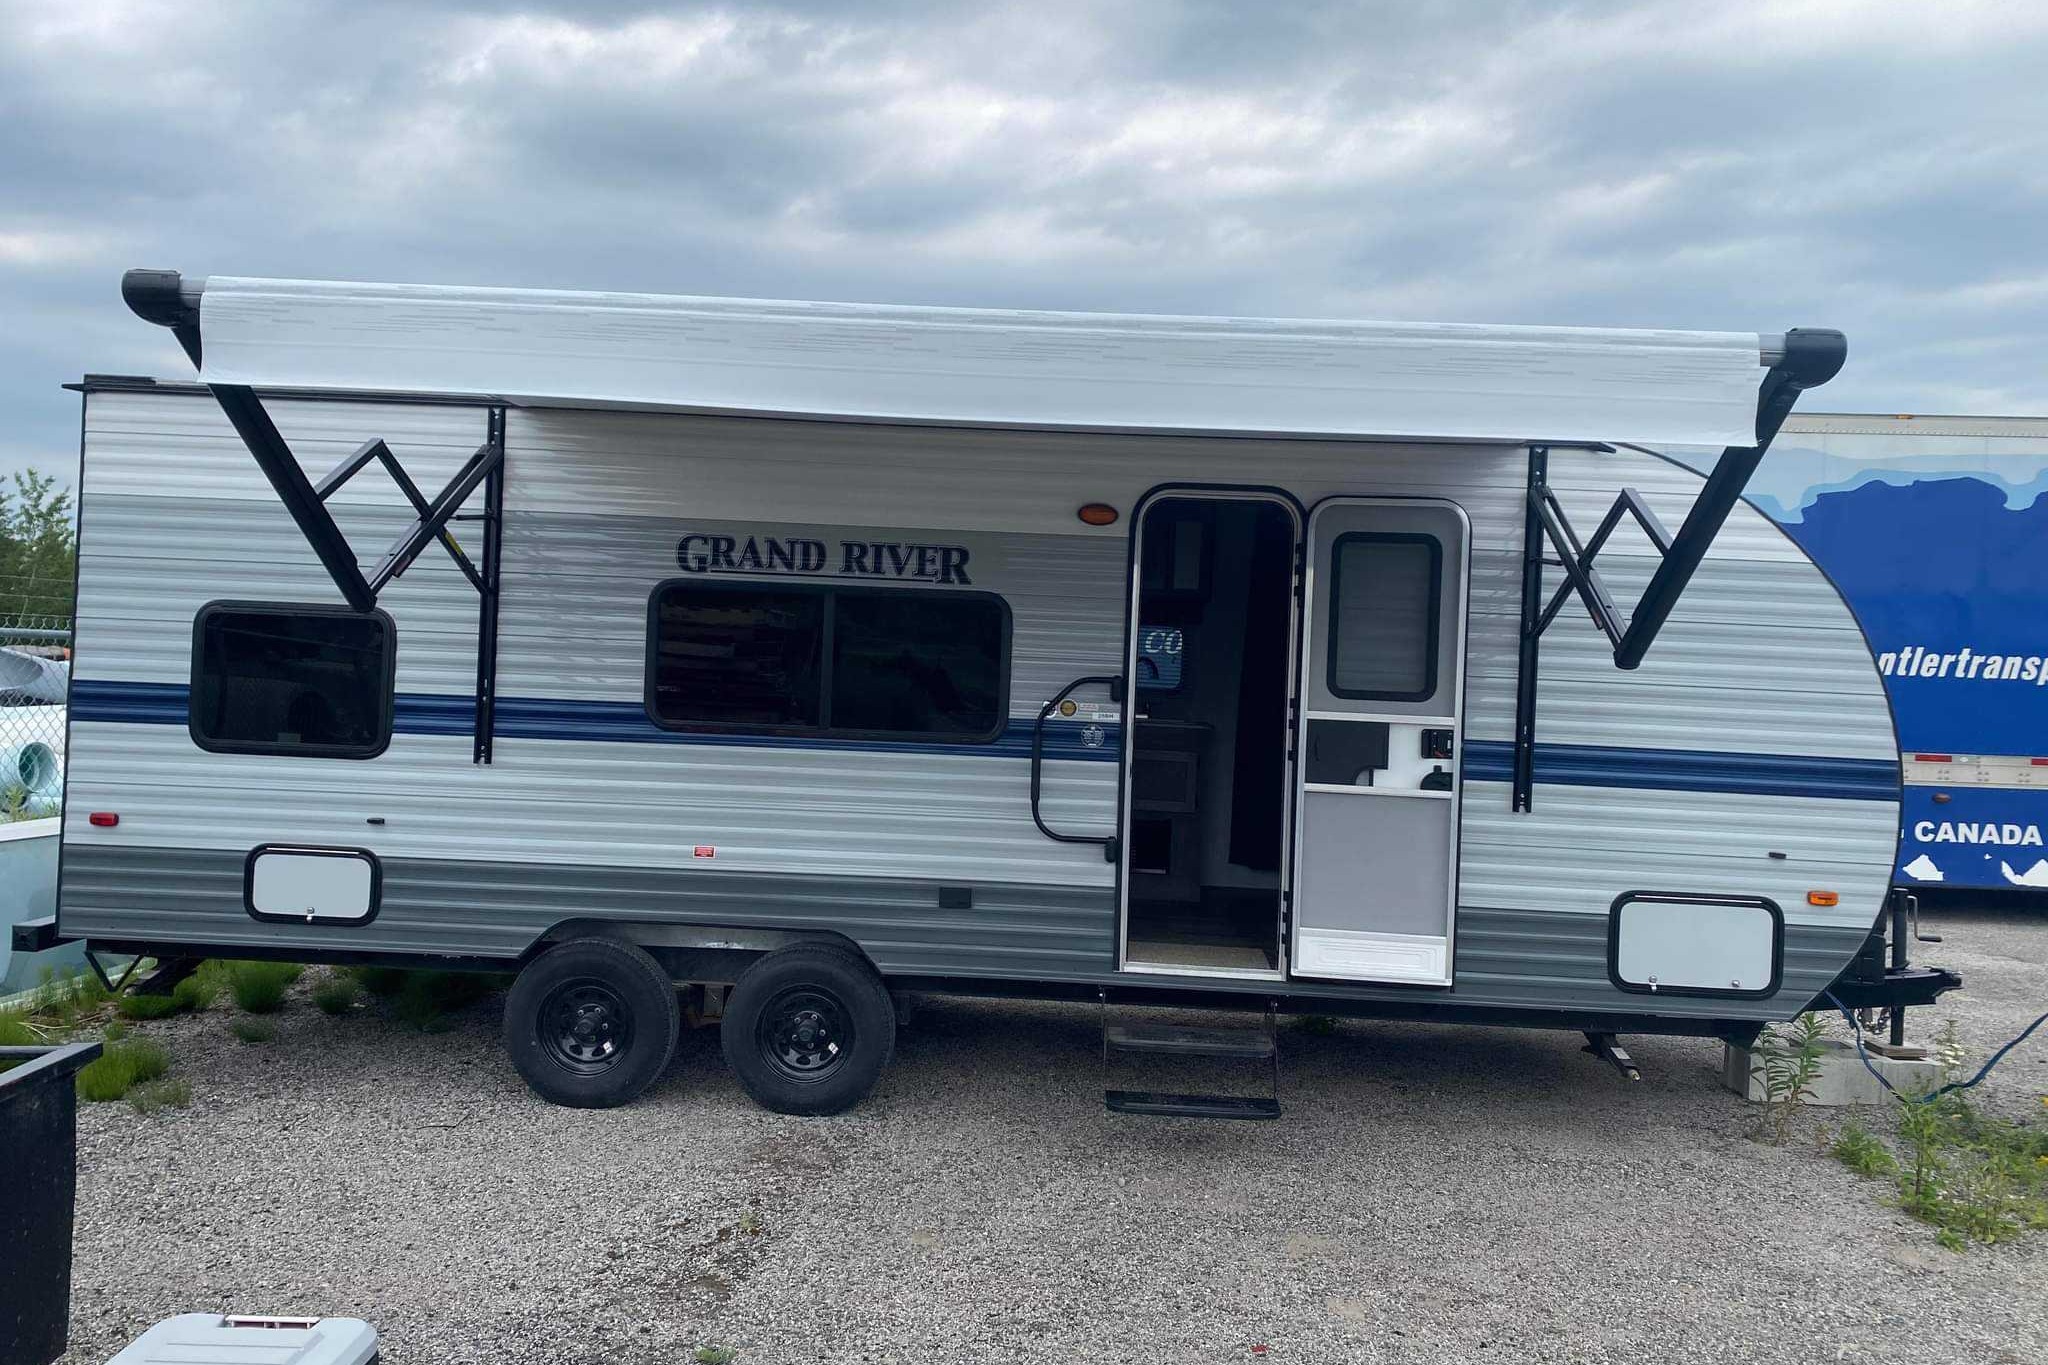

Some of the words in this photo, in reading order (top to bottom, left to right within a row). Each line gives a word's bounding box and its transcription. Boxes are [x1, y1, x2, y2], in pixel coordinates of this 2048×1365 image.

[677, 533, 827, 573] GRAND
[839, 539, 972, 585] RIVER
[1914, 821, 2044, 846] CANADA
